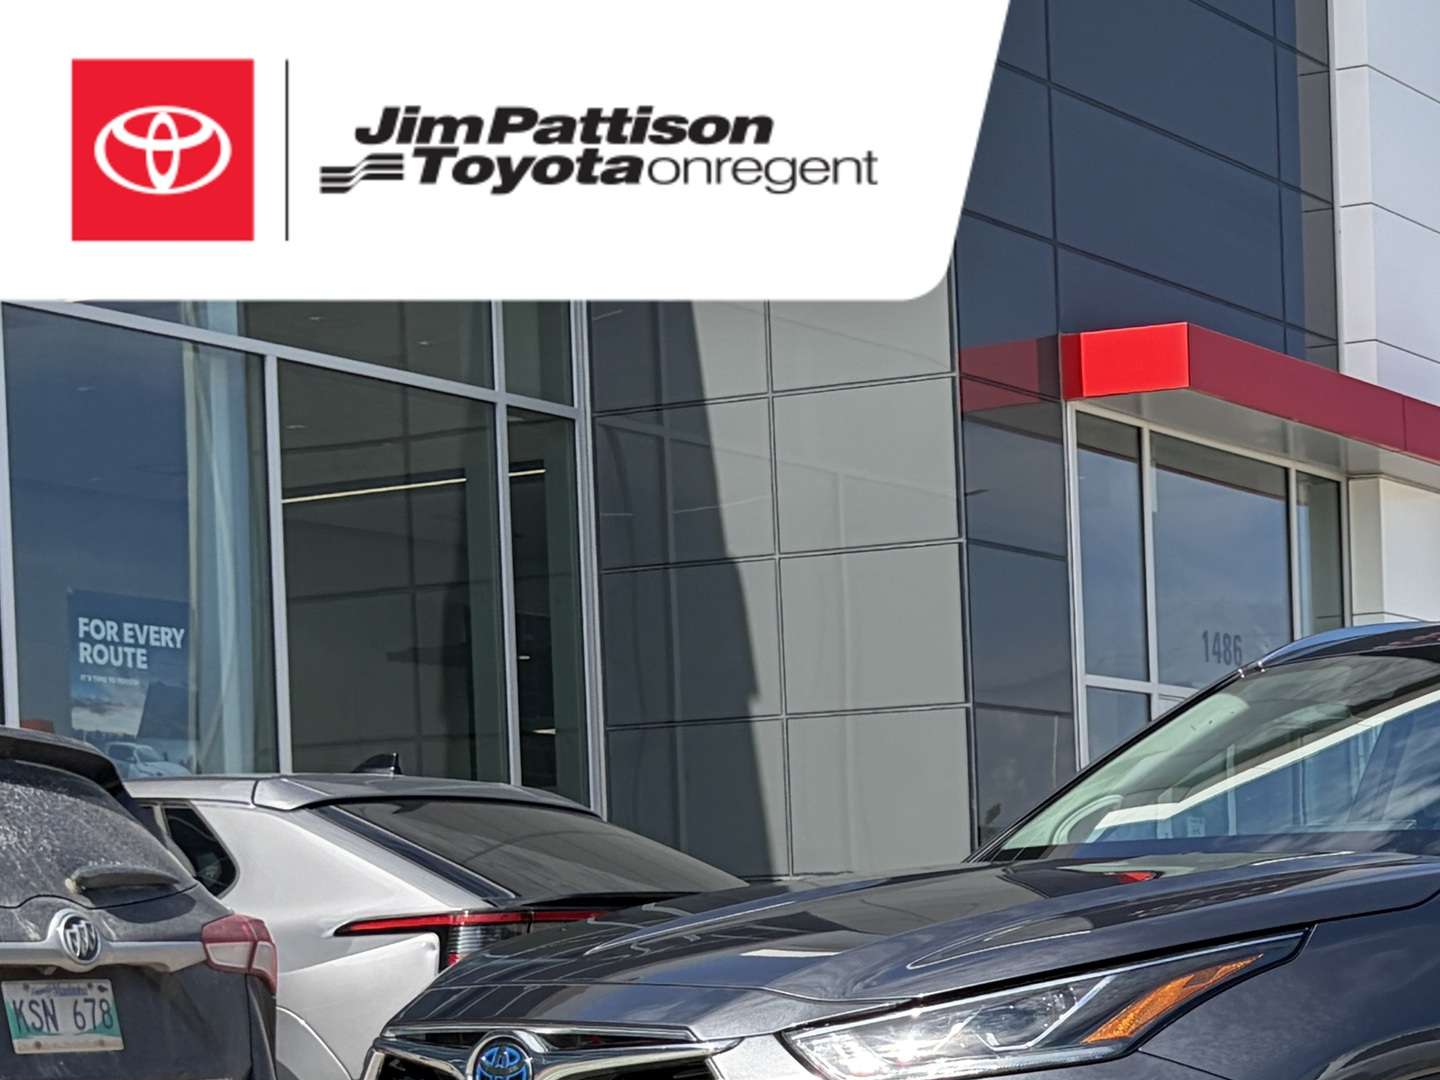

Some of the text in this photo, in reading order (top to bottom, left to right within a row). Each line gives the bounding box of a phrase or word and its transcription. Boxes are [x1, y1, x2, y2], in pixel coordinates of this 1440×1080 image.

[78, 617, 185, 649] FOR EVERY
[1202, 630, 1243, 667] 1486
[79, 643, 149, 670] ROUTE
[13, 998, 114, 1033] KSN 678
